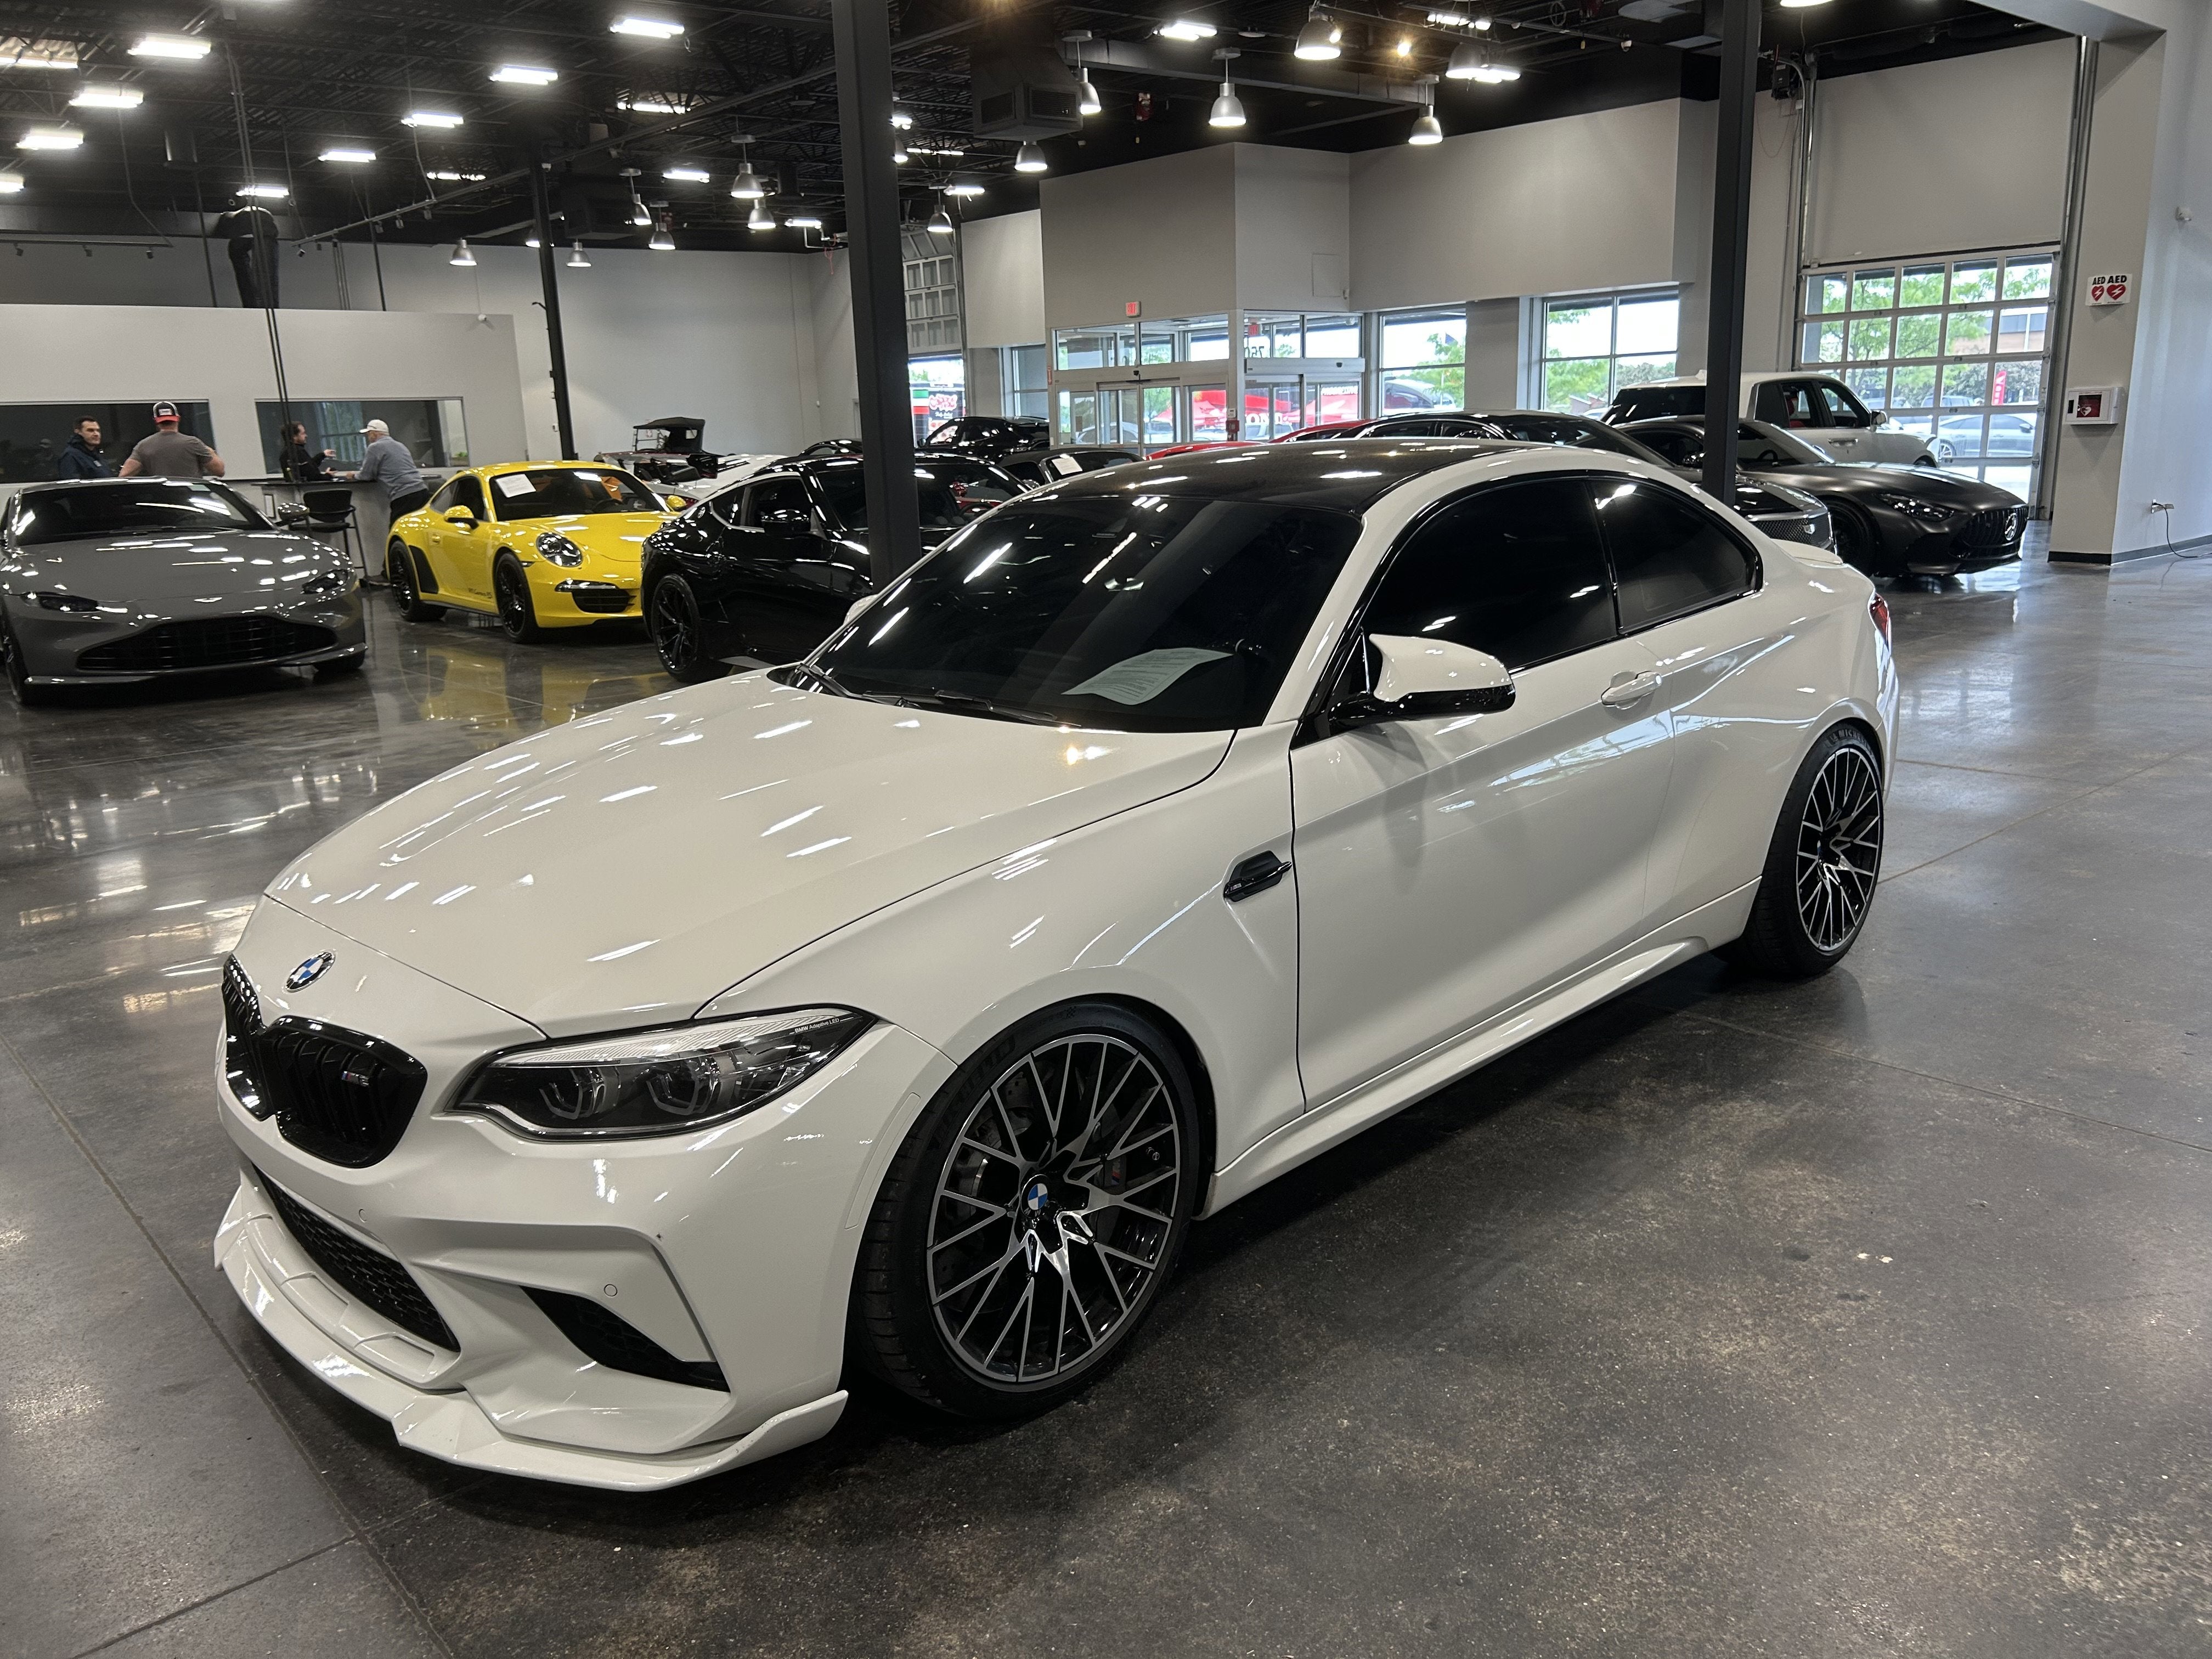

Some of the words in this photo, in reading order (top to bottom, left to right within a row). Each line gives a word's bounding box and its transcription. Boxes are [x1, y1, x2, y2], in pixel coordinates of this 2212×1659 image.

[2092, 276, 2106, 285] AED
[2107, 275, 2127, 284] AED
[809, 1021, 828, 1029] Adaptive
